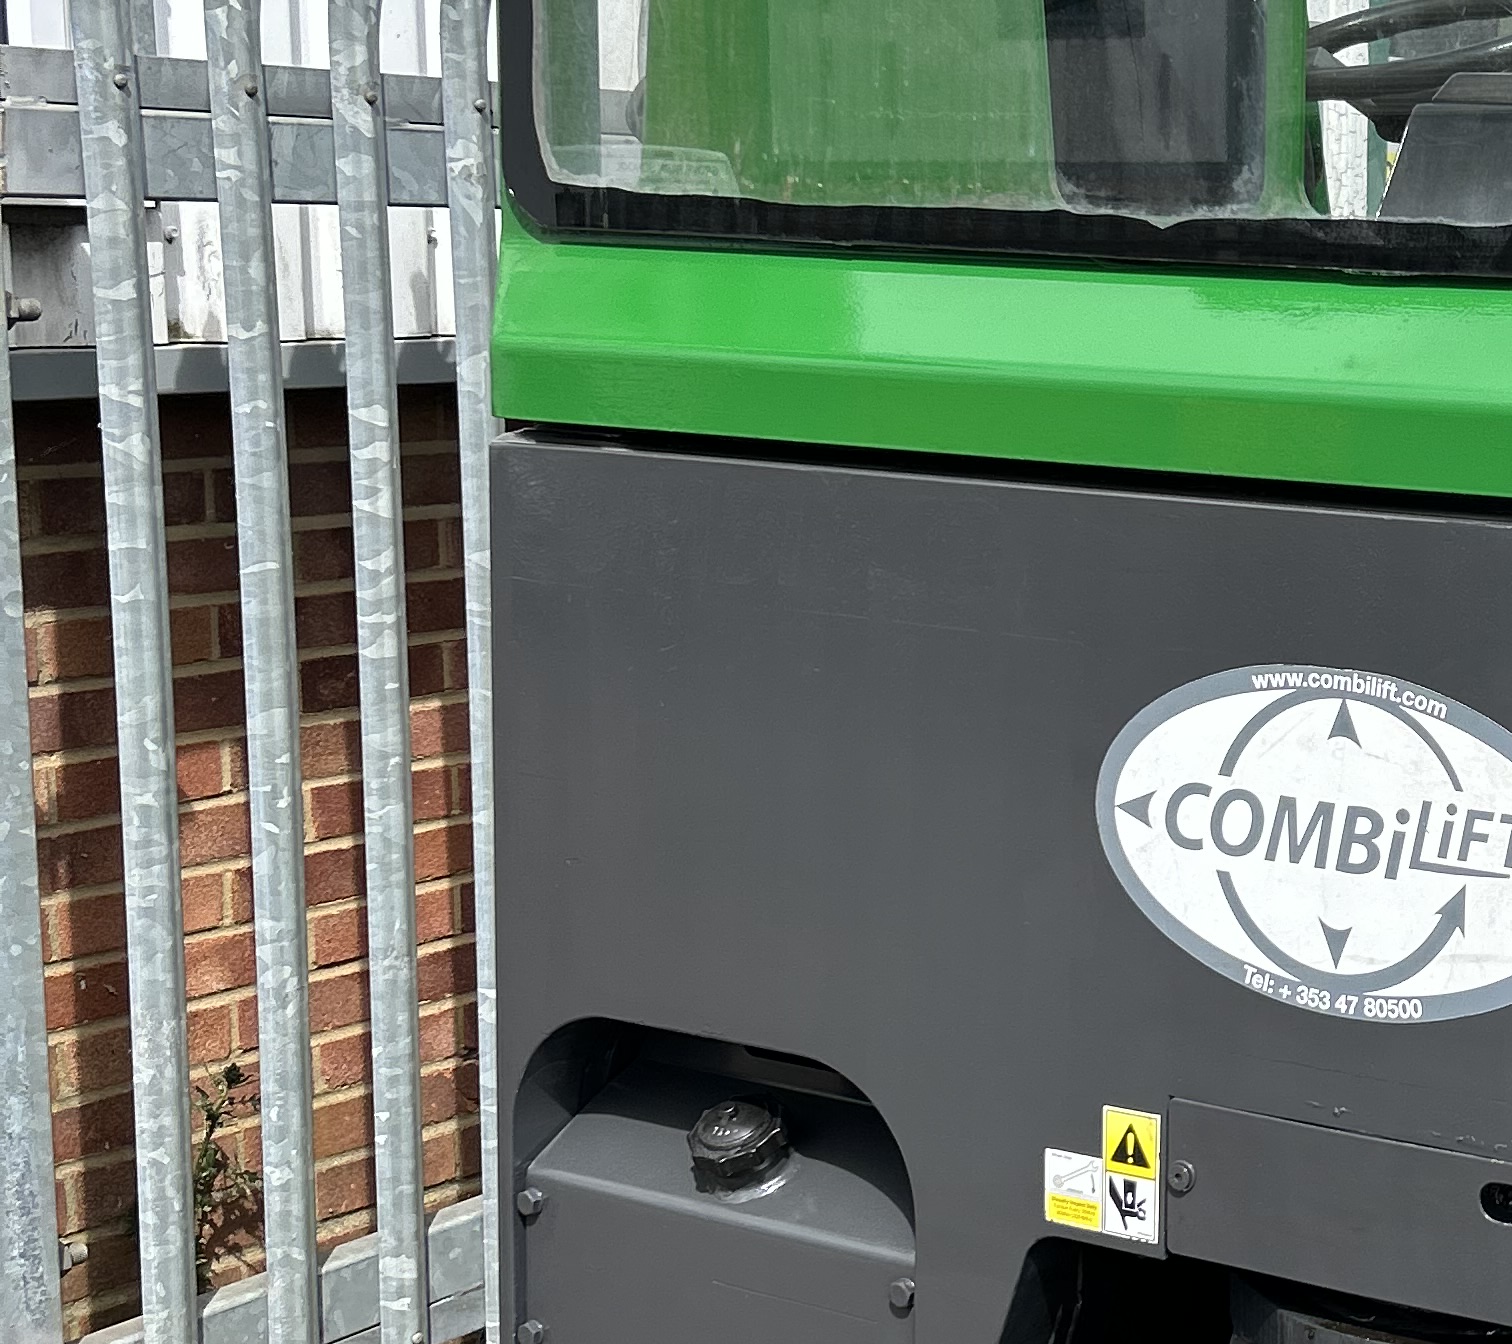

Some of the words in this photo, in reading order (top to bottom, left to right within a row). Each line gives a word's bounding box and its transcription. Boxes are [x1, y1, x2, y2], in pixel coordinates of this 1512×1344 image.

[1251, 671, 1448, 720] www.combilift.com
[1242, 963, 1275, 996] Tel:
[1295, 985, 1332, 1014] 353
[1334, 994, 1359, 1016] 47
[1362, 996, 1424, 1021] 80500
